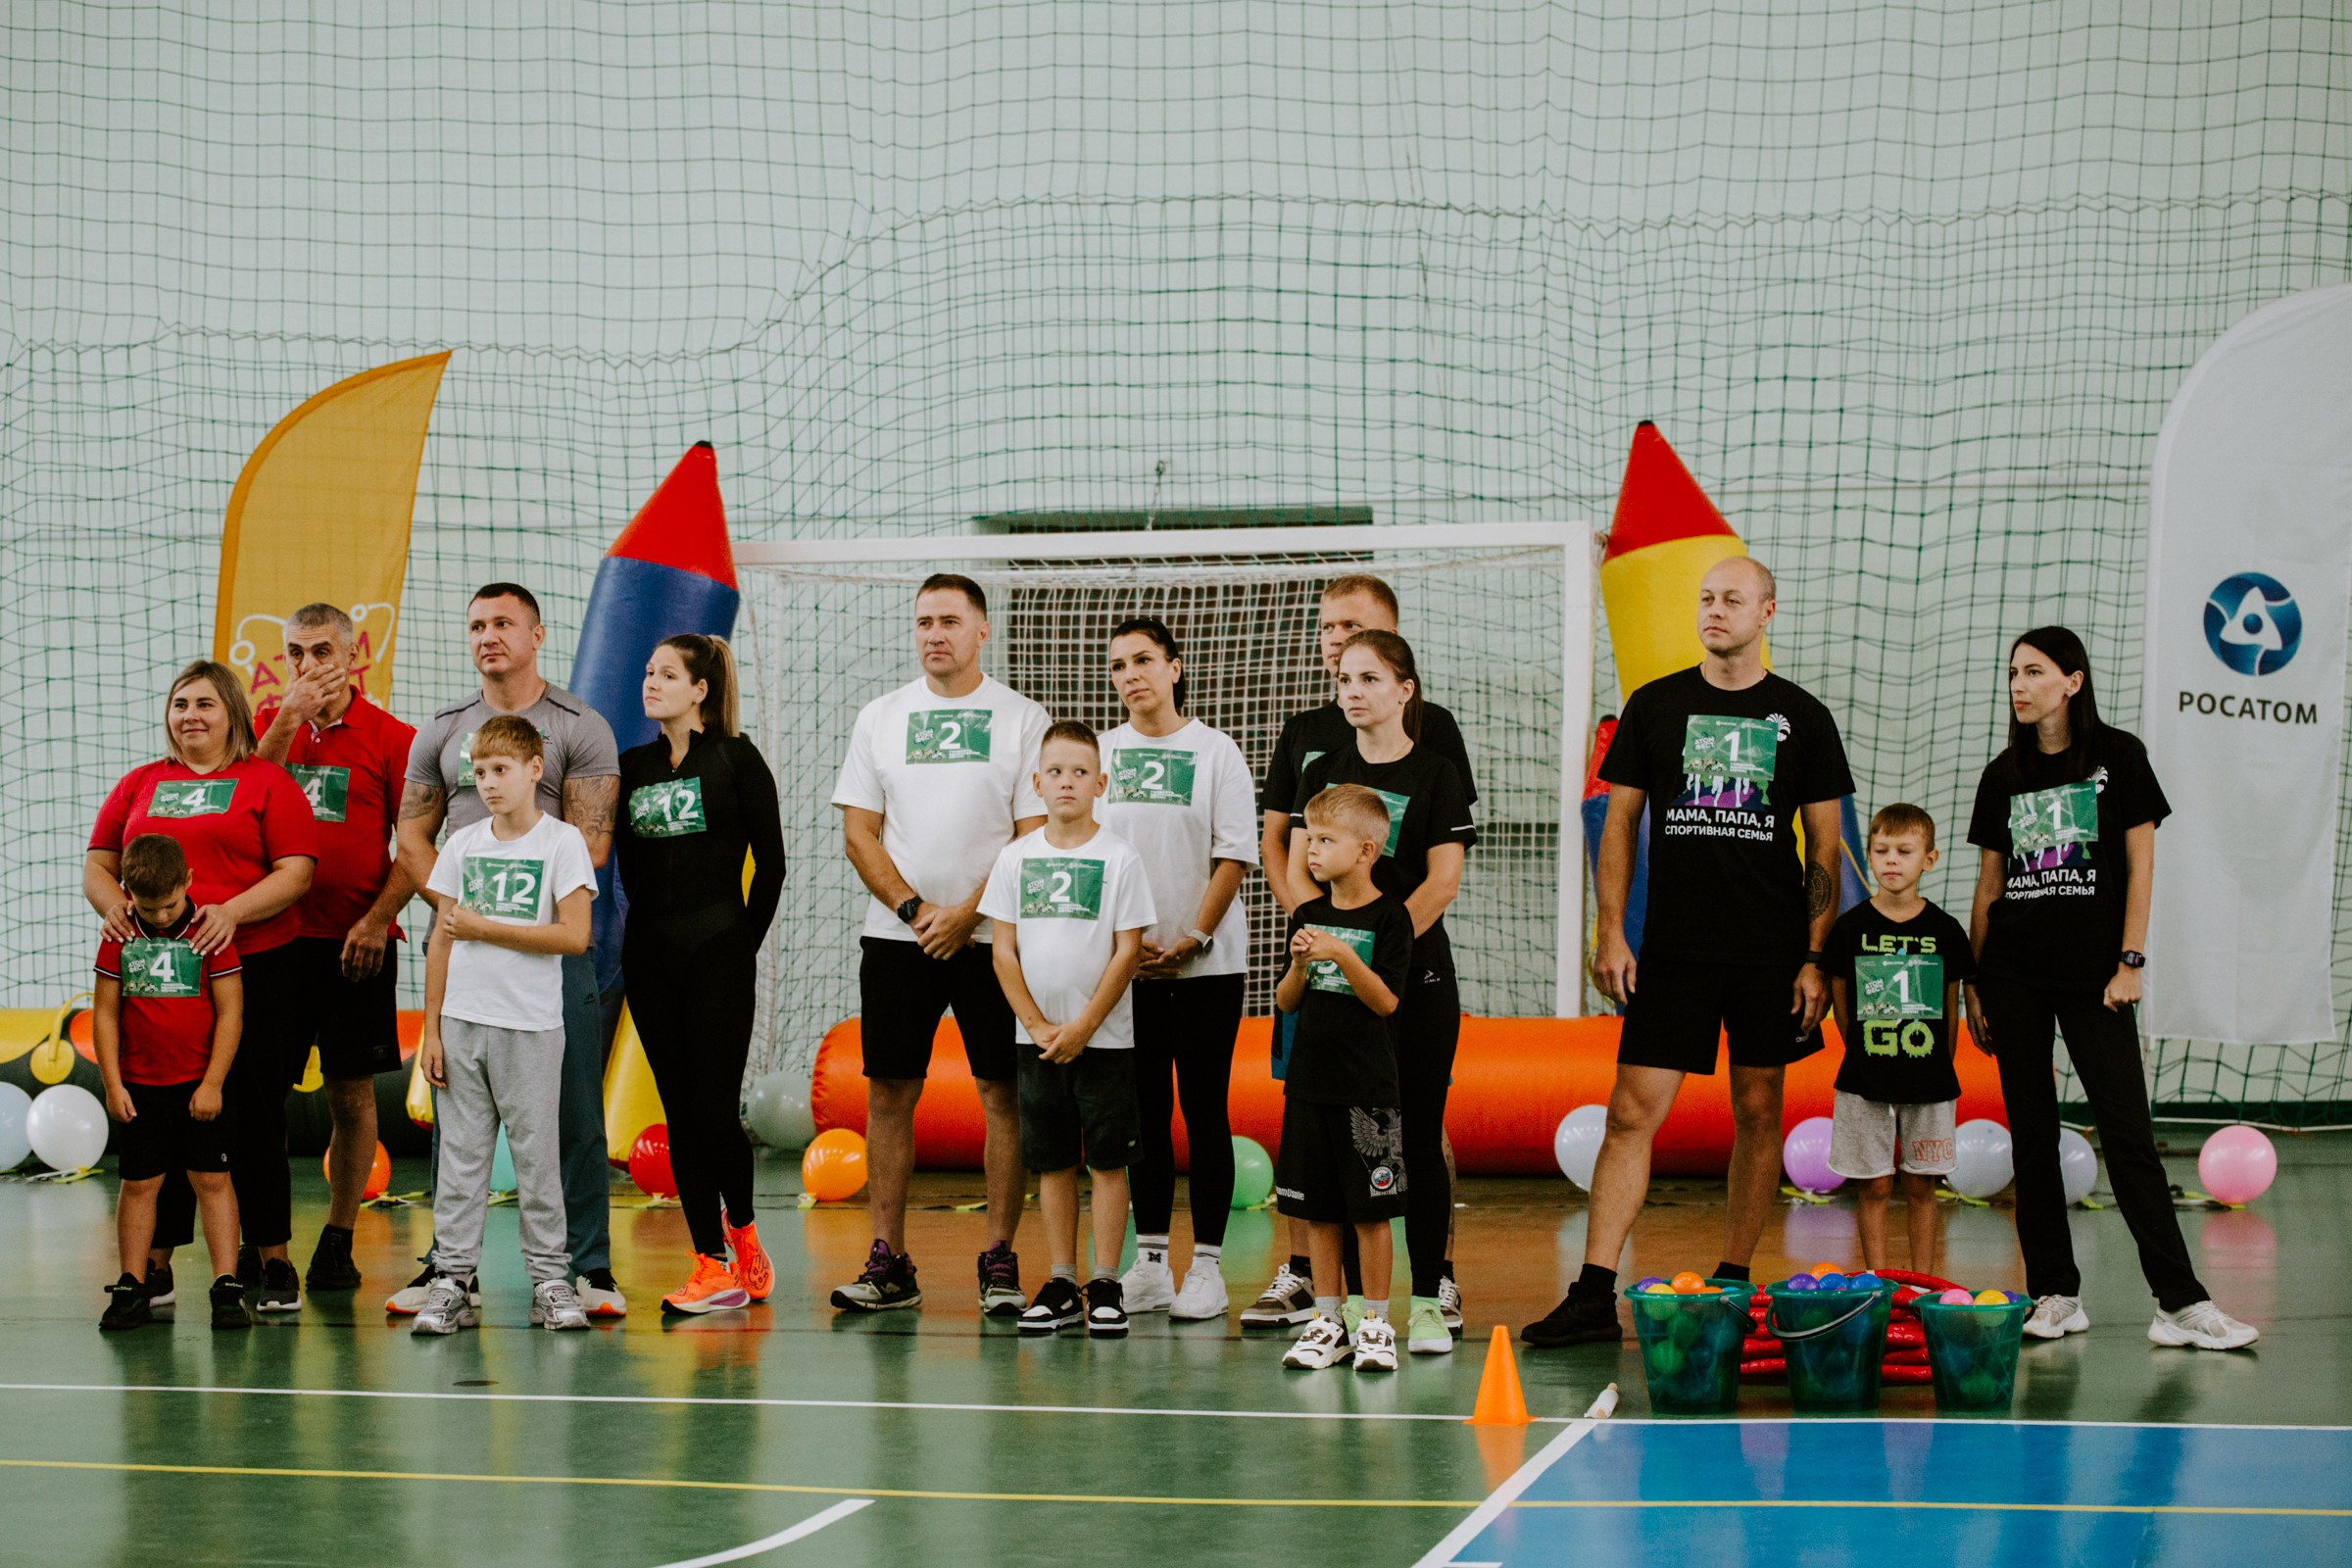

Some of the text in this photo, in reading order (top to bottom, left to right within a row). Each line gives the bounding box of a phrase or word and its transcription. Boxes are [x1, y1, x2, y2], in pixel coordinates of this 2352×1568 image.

[2179, 691, 2318, 724] РОСАТОМ
[940, 721, 961, 751] 2
[1724, 731, 1740, 762] 1
[1141, 760, 1165, 790] 2
[181, 787, 206, 808] 4
[303, 777, 321, 807] 4
[658, 789, 699, 822] 12
[1666, 808, 1775, 829] МАМА, ПАПА, Я
[2046, 801, 2061, 830] 1
[1665, 825, 1774, 842] СПОРТИВНАЯ СЕМЬЯ
[492, 871, 536, 906] 12
[1050, 871, 1072, 903] 2
[2041, 869, 2083, 885] ПАПА,
[2086, 869, 2096, 882] Я
[2058, 885, 2095, 896] СЕМЬЯ
[1862, 934, 1936, 955] LET'S
[150, 952, 174, 983] 4
[1892, 970, 1909, 1004] 1
[1863, 1019, 1935, 1058] GO
[1912, 1138, 1953, 1162] NYC
